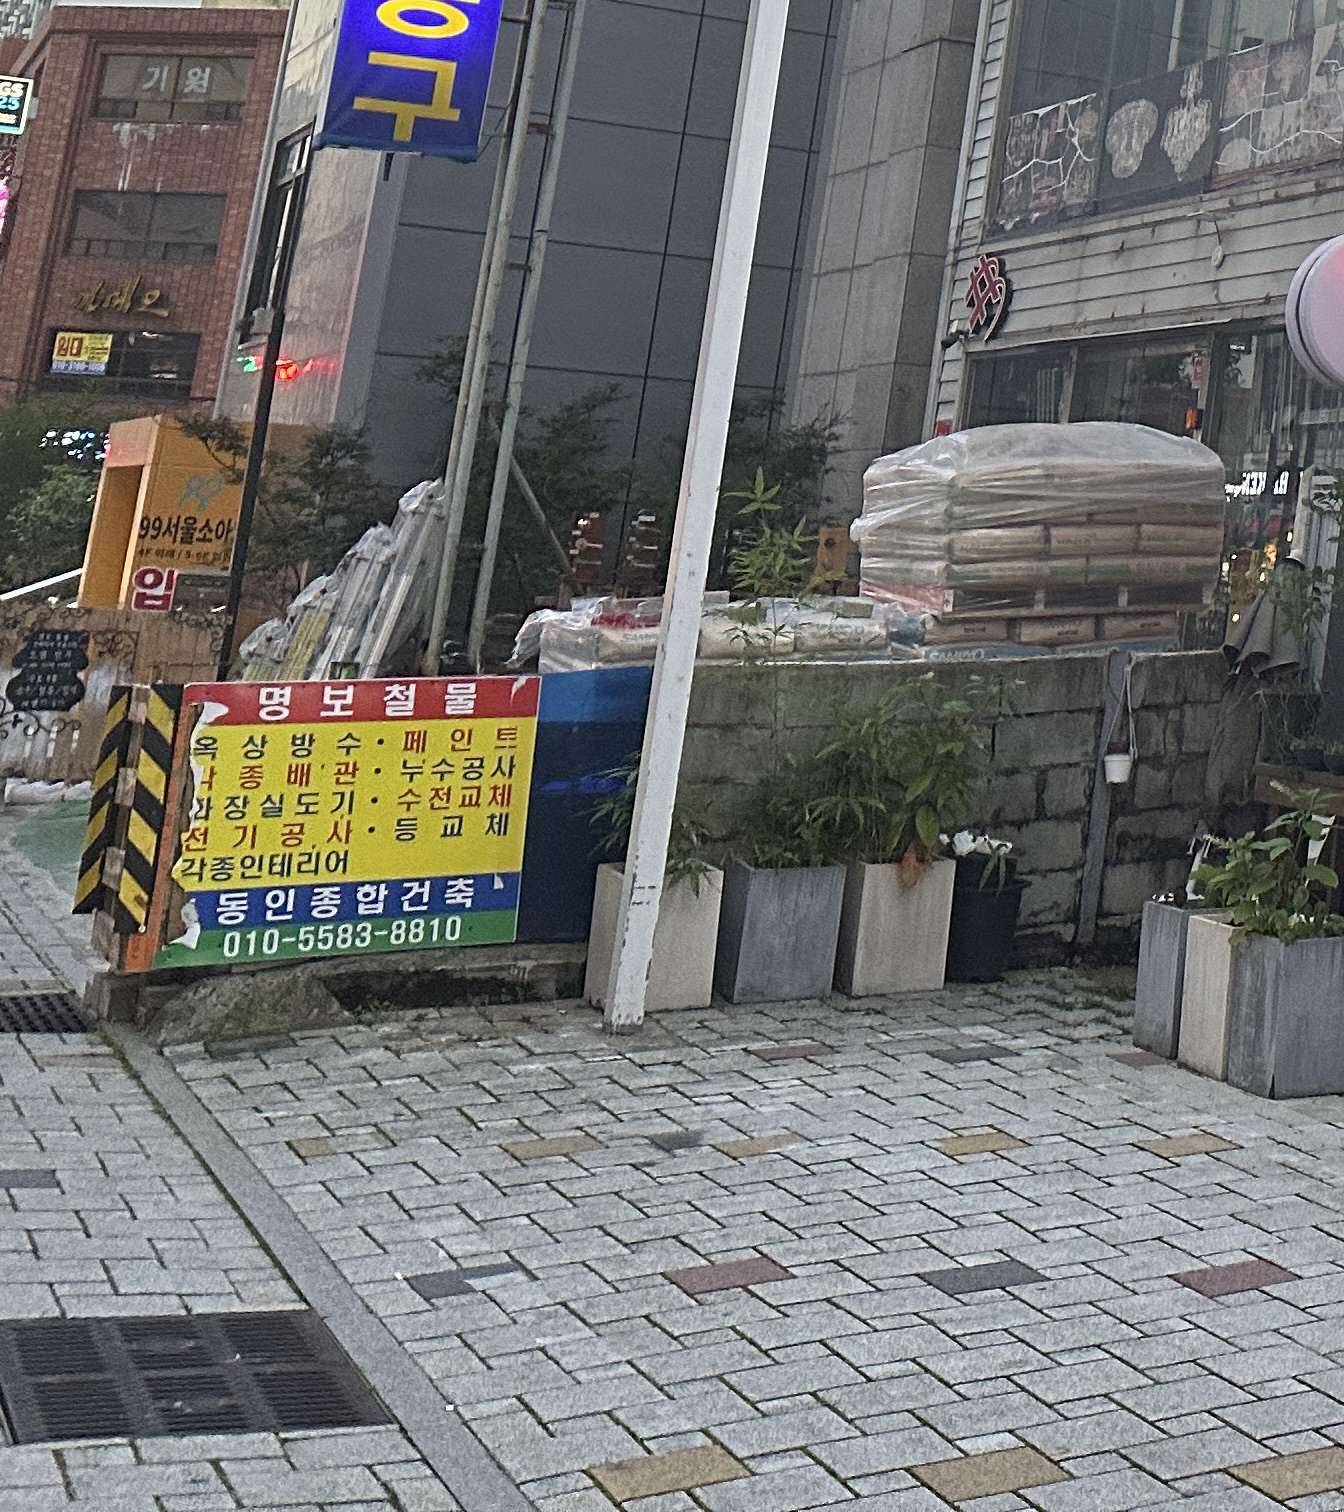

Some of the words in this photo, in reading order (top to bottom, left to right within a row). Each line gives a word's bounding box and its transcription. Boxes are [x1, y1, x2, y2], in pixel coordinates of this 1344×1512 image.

[258, 680, 478, 721] 명보철물
[193, 731, 363, 761] 옥상방수
[403, 726, 519, 755] 페인트
[400, 754, 518, 784] 누수공사
[396, 784, 513, 813] 수전교체
[182, 821, 355, 852] 전기공사
[393, 812, 510, 842] 등교체
[180, 848, 349, 883] 각종인테리어
[216, 876, 476, 925] 동인종합건축
[223, 914, 462, 958] 010-5583-8810
